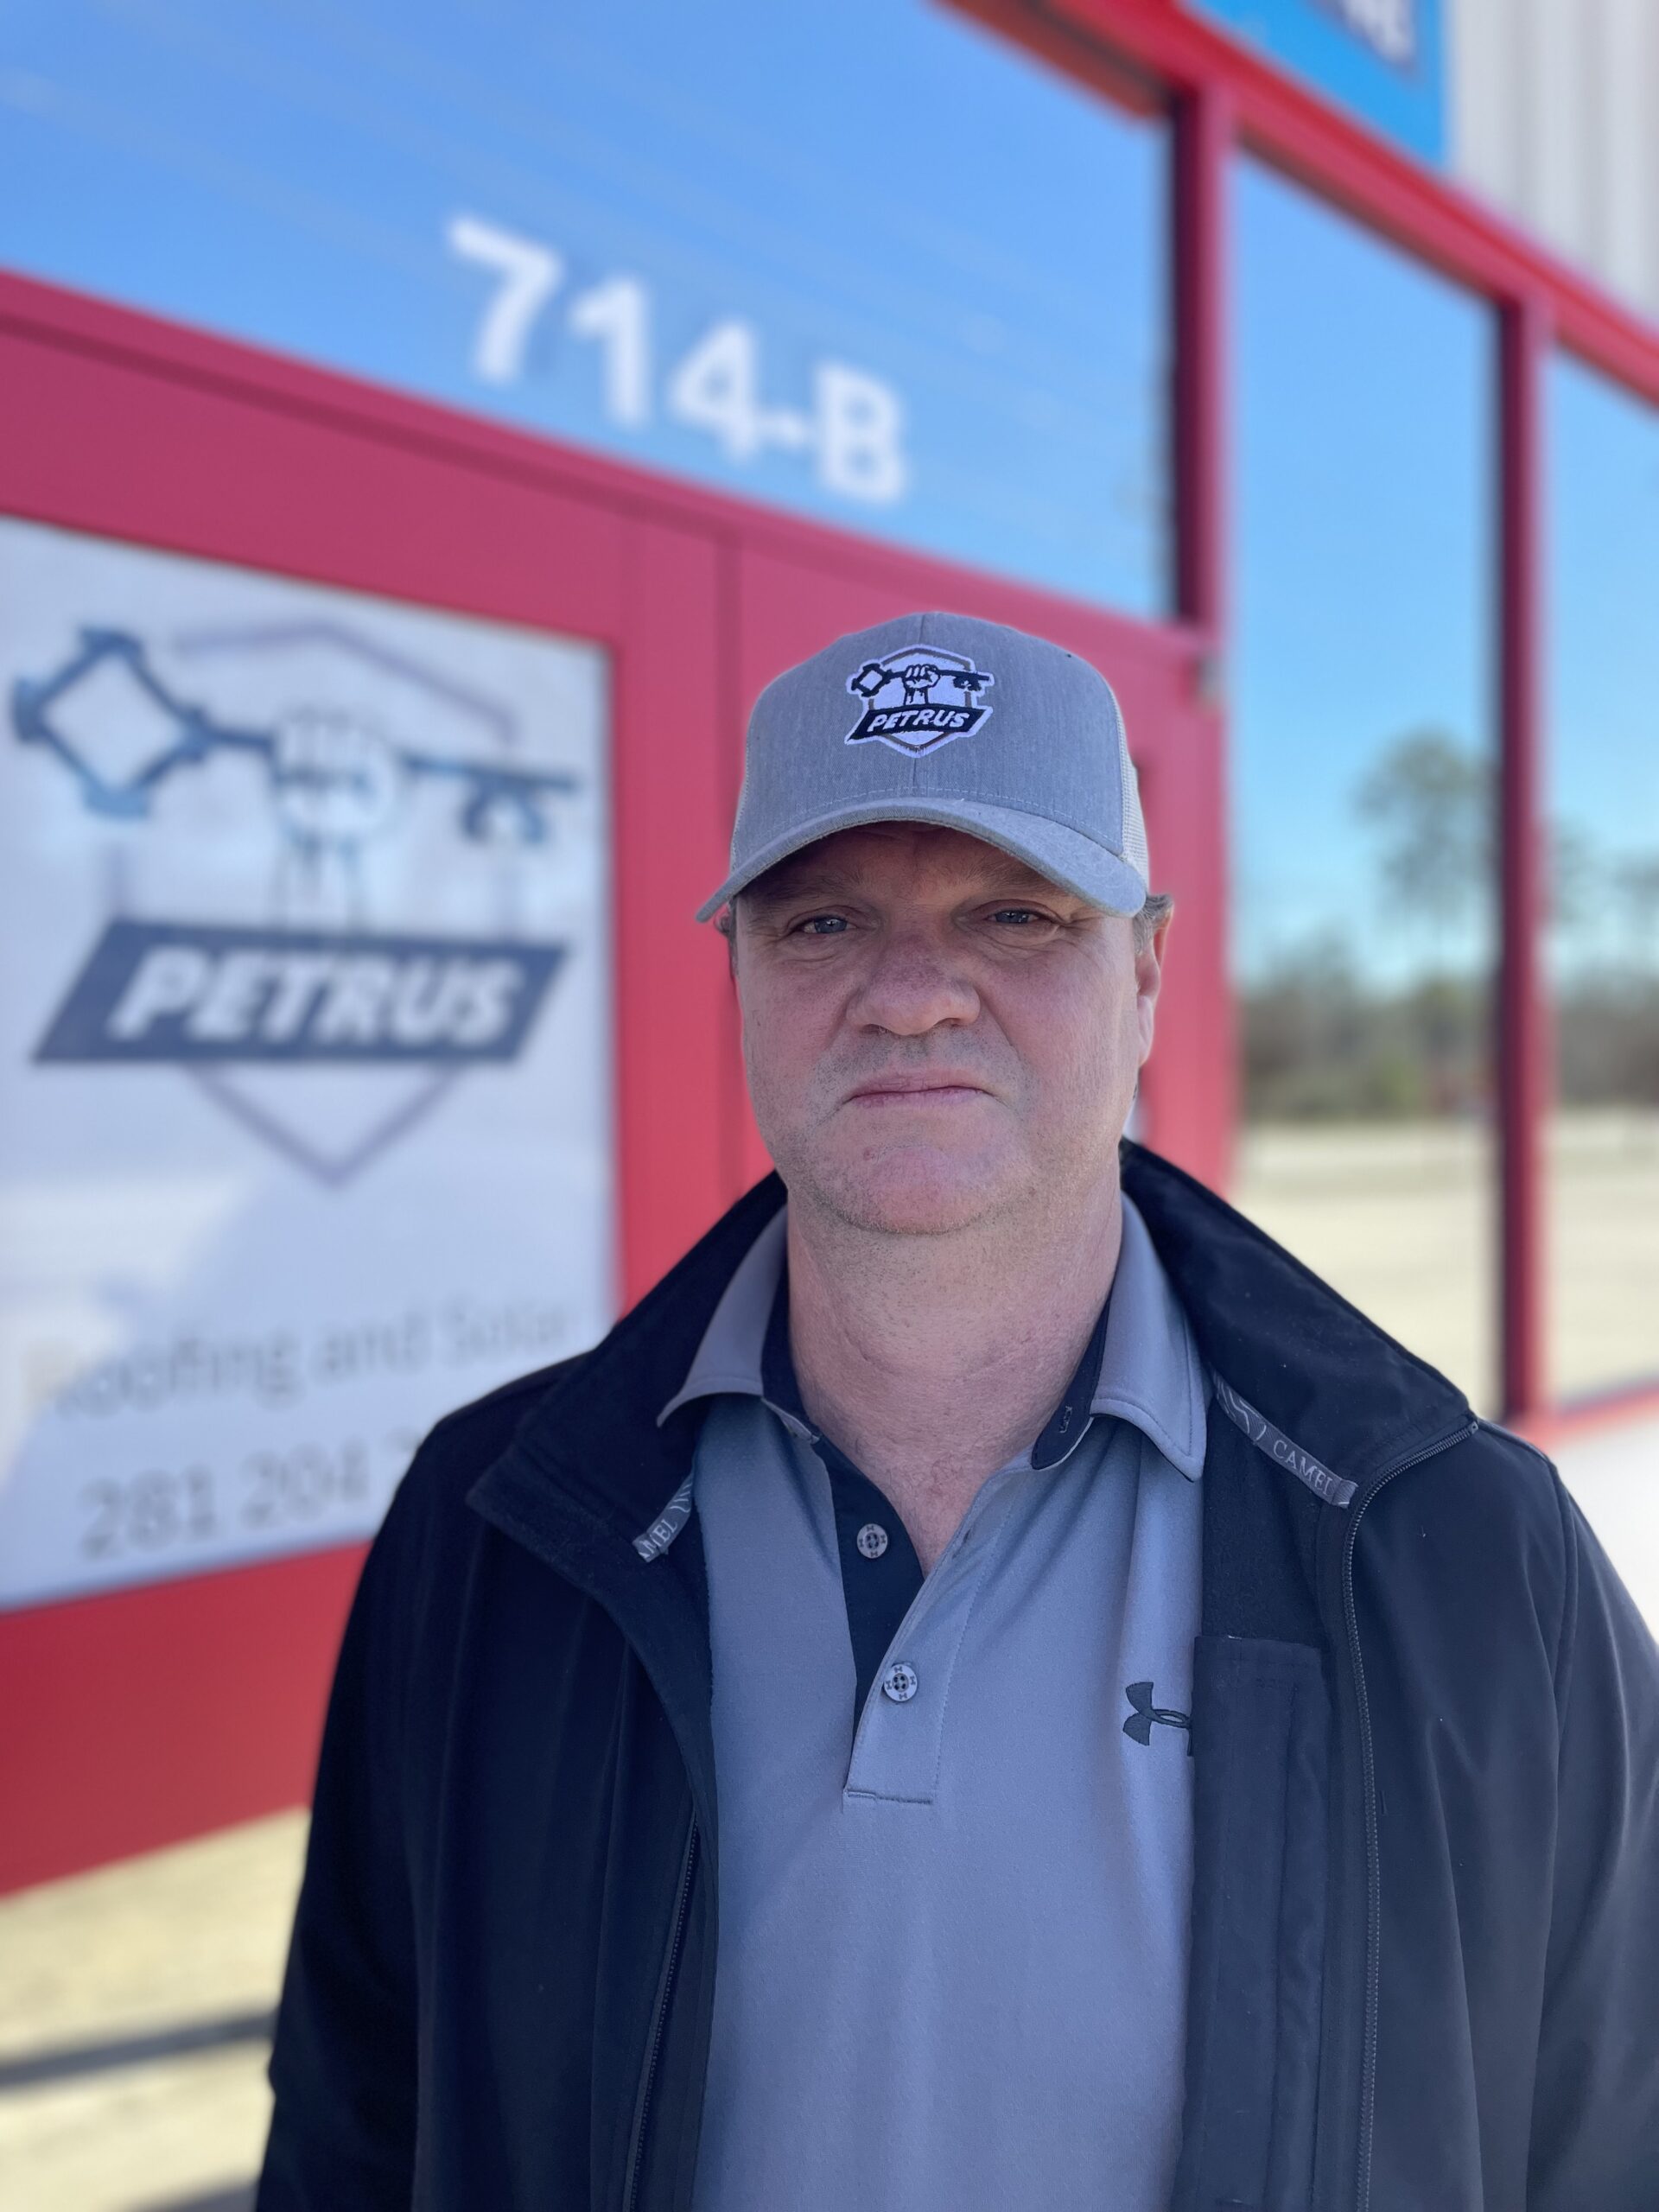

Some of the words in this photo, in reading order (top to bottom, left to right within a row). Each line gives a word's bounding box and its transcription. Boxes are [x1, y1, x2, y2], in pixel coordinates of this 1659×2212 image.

[448, 218, 906, 505] 714-B
[867, 709, 969, 733] PETRUS
[108, 948, 521, 1044] PETRUS
[309, 1307, 429, 1385] and
[1272, 1438, 1336, 1497] CAMEL
